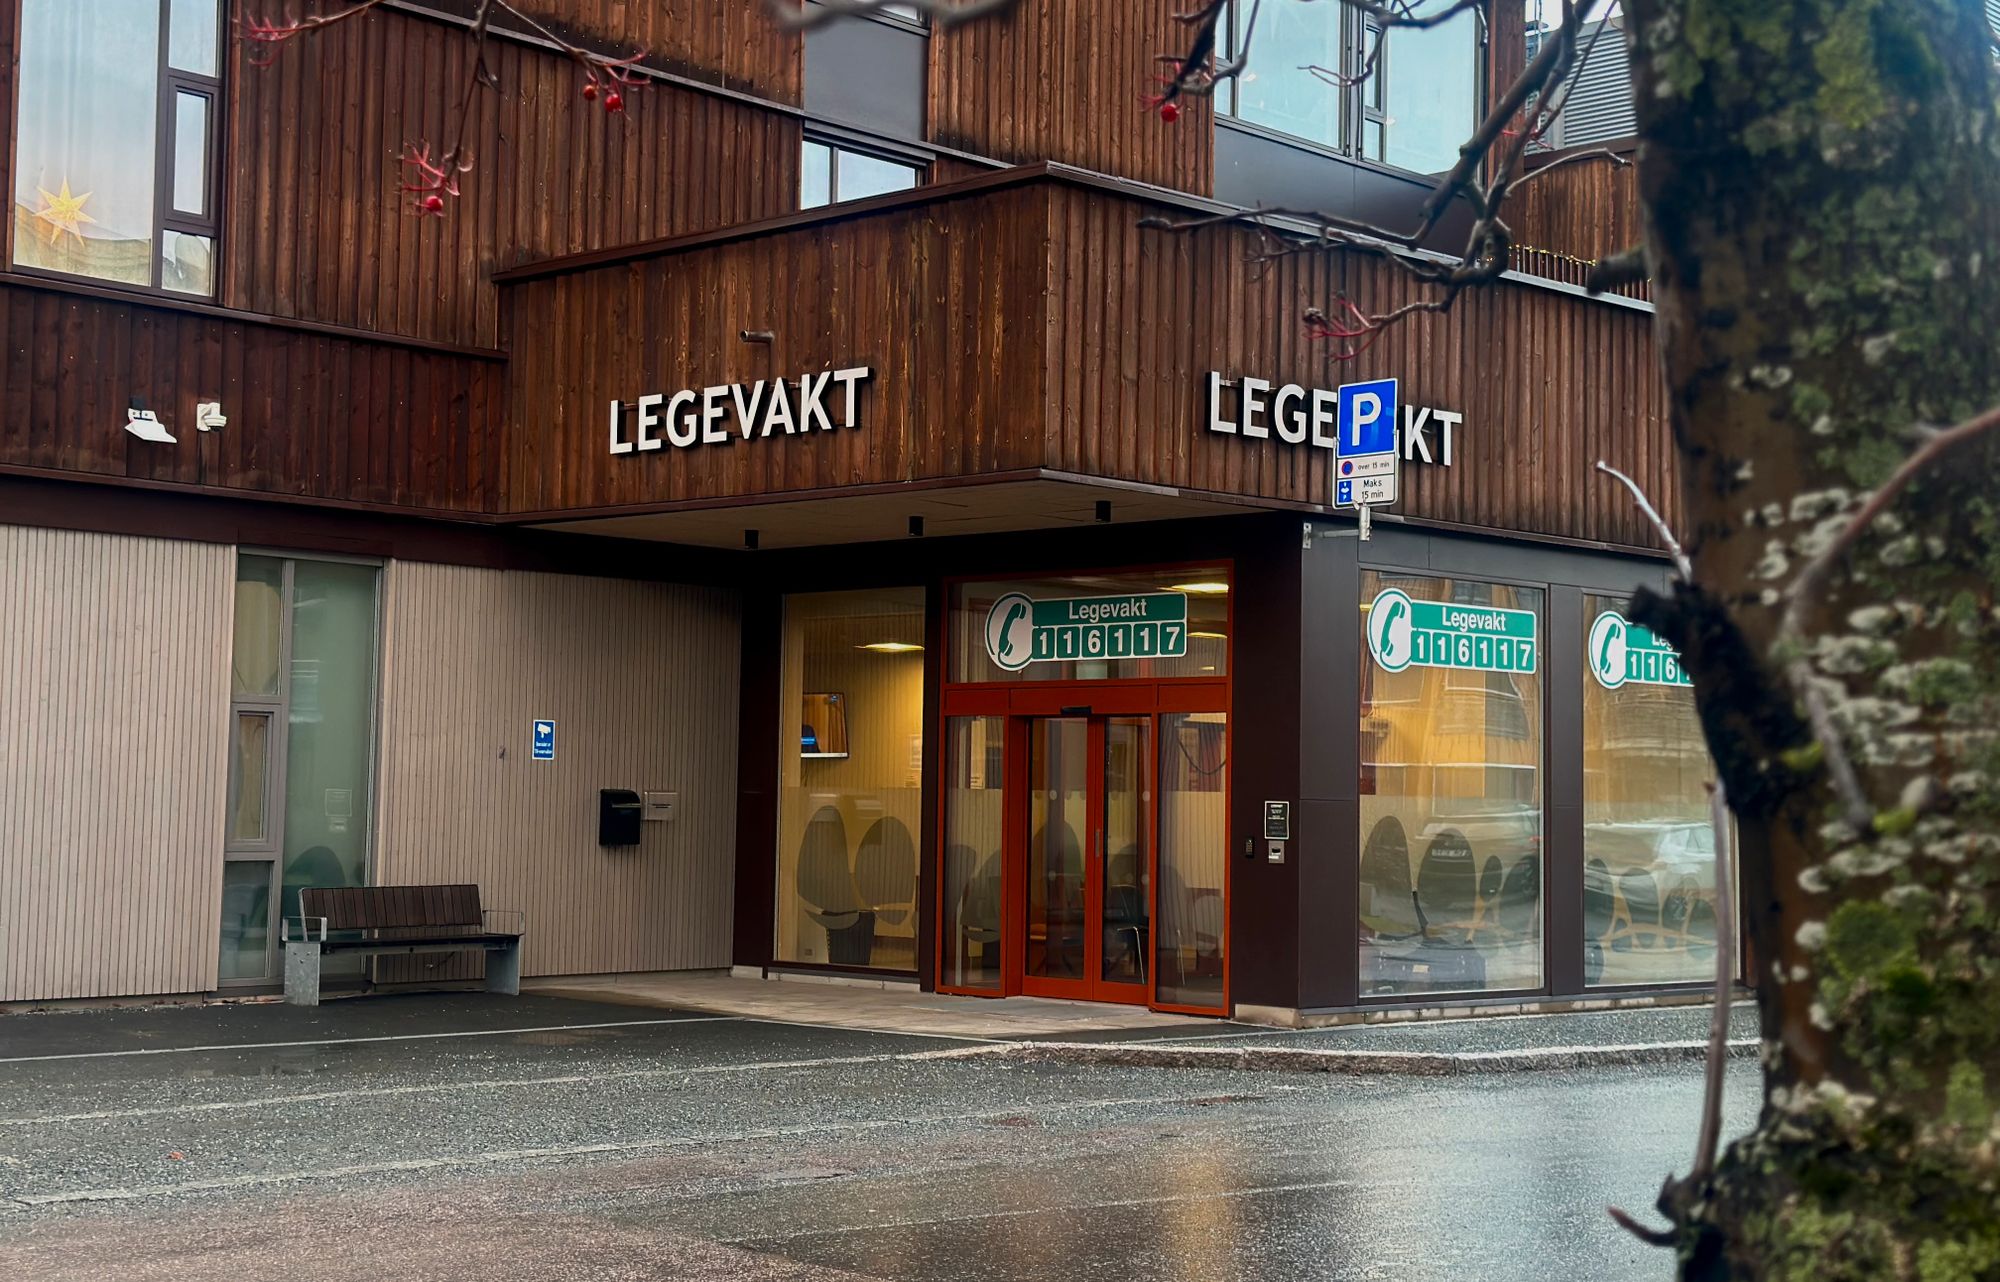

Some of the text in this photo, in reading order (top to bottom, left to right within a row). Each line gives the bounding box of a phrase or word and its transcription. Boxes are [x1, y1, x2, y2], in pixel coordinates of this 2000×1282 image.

[609, 366, 869, 454] LEGEVAKT
[1210, 371, 1462, 466] LEGEKT
[1351, 392, 1382, 446] P
[1361, 490, 1384, 500] 15 min
[1363, 479, 1383, 488] Maks
[1069, 598, 1147, 623] Legevakt
[1442, 606, 1506, 632] Legevakt
[1039, 626, 1181, 655] 116117
[1417, 634, 1532, 667] 116117
[1630, 653, 1690, 681] 116
